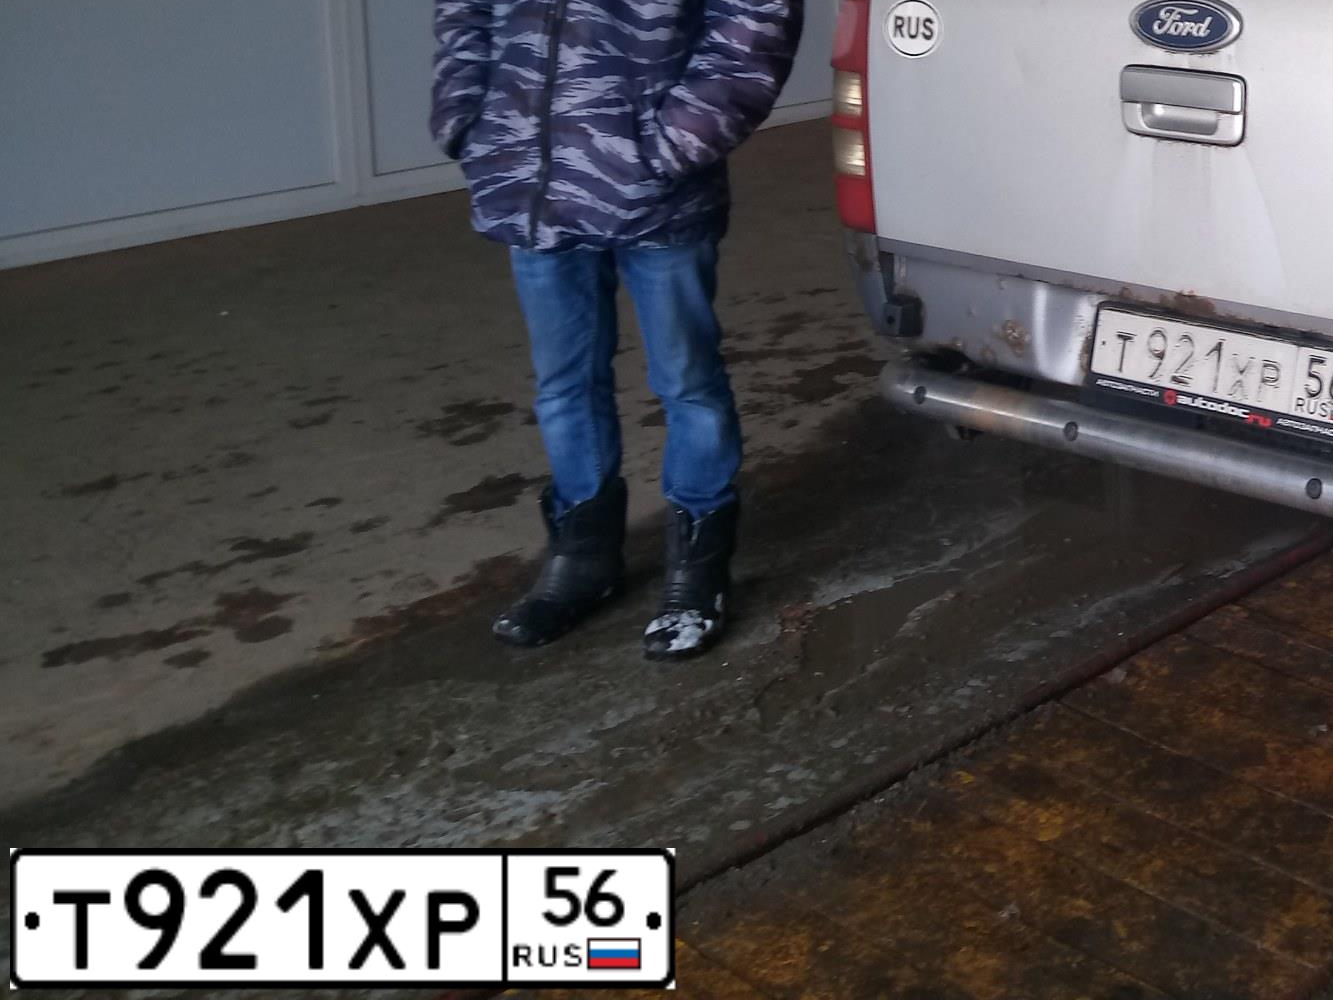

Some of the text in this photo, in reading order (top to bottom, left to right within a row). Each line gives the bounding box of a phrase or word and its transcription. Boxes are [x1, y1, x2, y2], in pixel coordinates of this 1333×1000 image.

[893, 15, 934, 41] RUS
[1152, 6, 1213, 37] Ford
[1294, 397, 1328, 418] RUS
